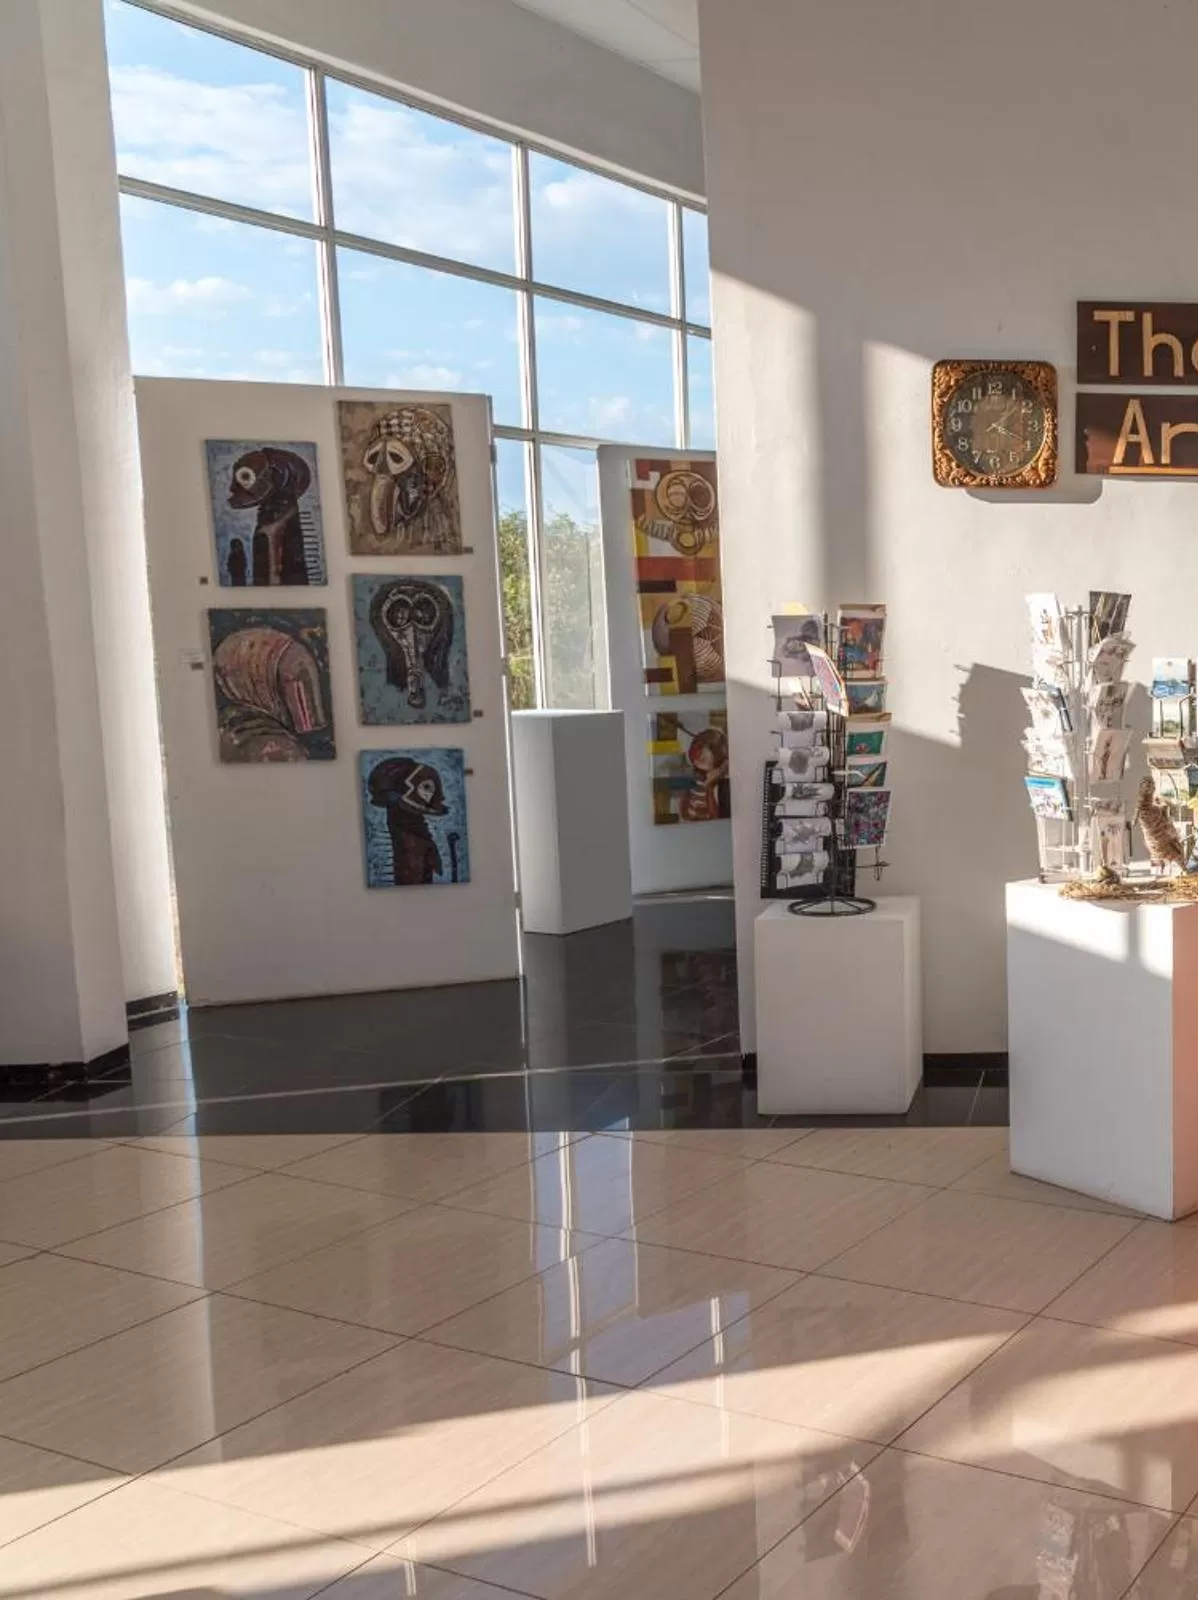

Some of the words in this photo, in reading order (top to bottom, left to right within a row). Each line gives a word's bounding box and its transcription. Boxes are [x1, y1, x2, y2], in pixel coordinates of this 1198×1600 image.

[972, 388, 982, 399] 11
[988, 382, 1002, 394] 12
[958, 400, 972, 413] 10
[1021, 401, 1033, 413] 2
[951, 418, 961, 432] 9
[958, 437, 968, 451] 8
[972, 450, 982, 464] 7
